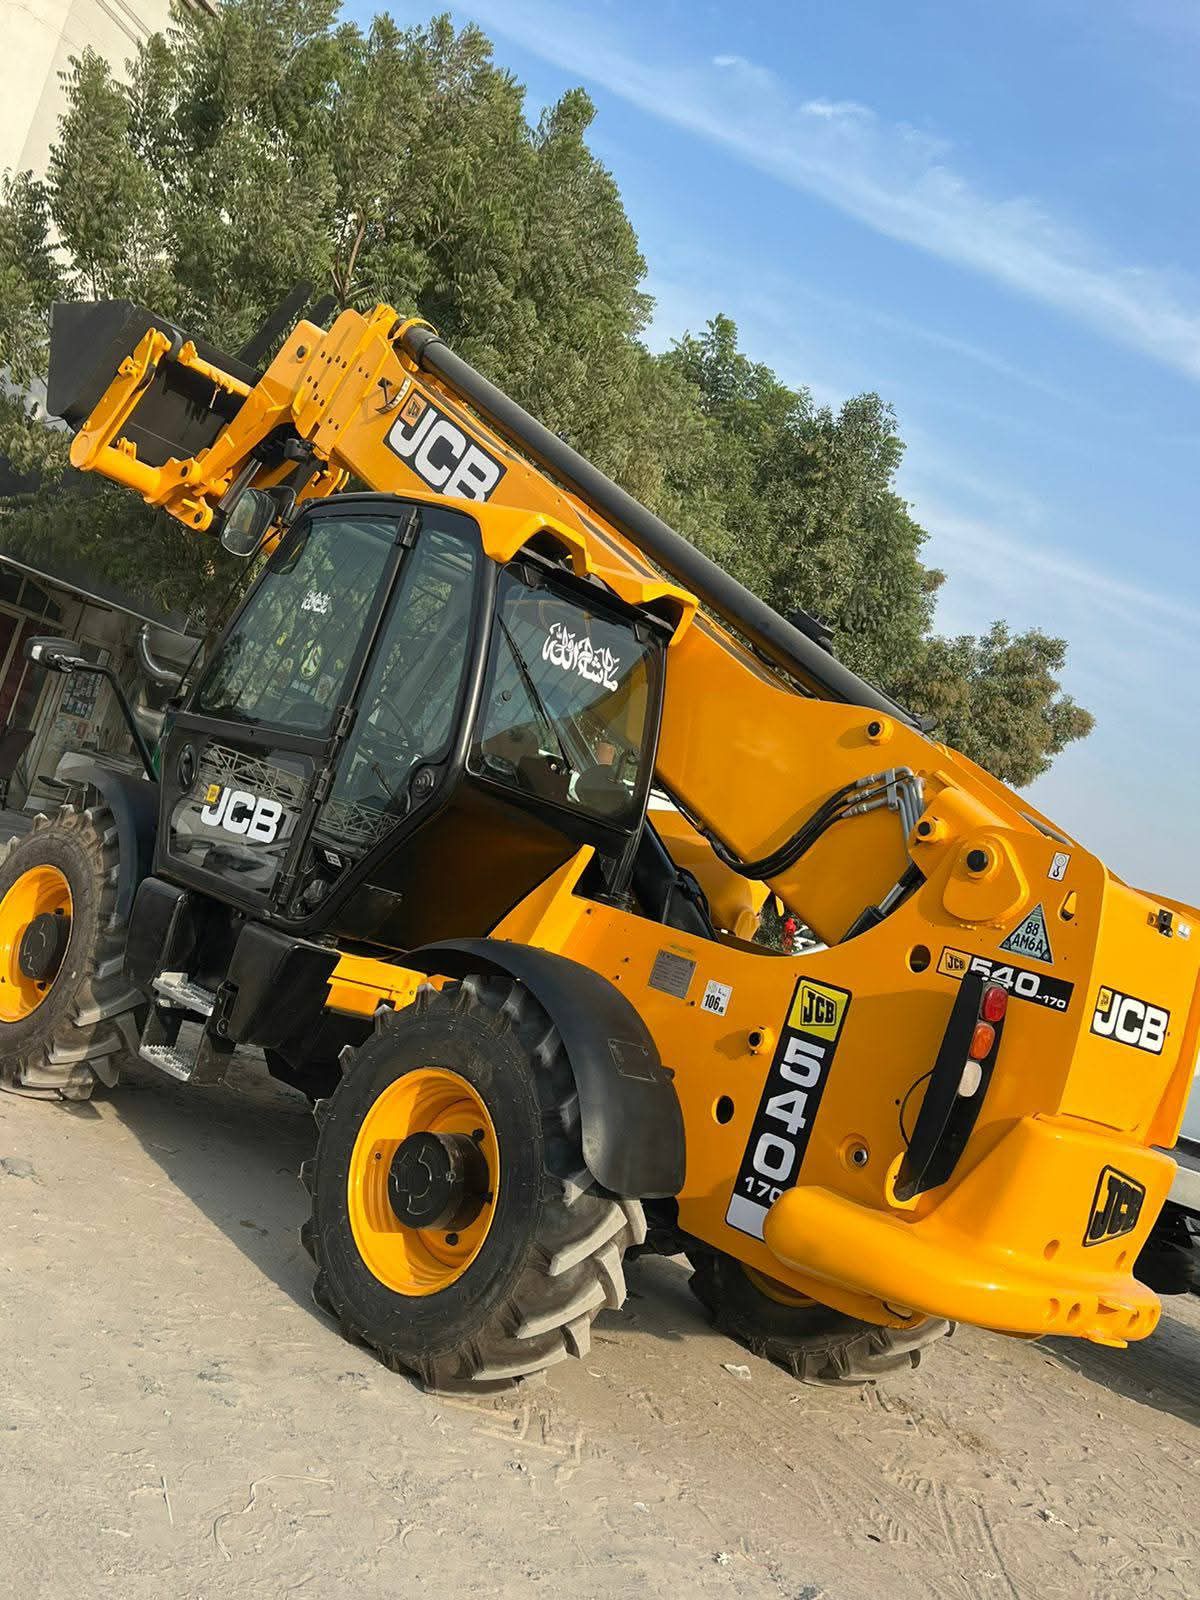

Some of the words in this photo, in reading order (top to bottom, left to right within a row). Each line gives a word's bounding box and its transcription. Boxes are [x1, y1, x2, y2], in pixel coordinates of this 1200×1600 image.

[389, 407, 500, 503] JCB
[201, 786, 283, 844] JCB
[1011, 932, 1044, 953] AM6A
[1025, 921, 1040, 936] 88
[947, 955, 965, 970] JCB
[704, 994, 721, 1011] 106
[803, 989, 836, 1024] JCB
[1093, 993, 1169, 1052] JCB
[753, 1036, 826, 1182] 540
[1089, 1174, 1144, 1240] JCB
